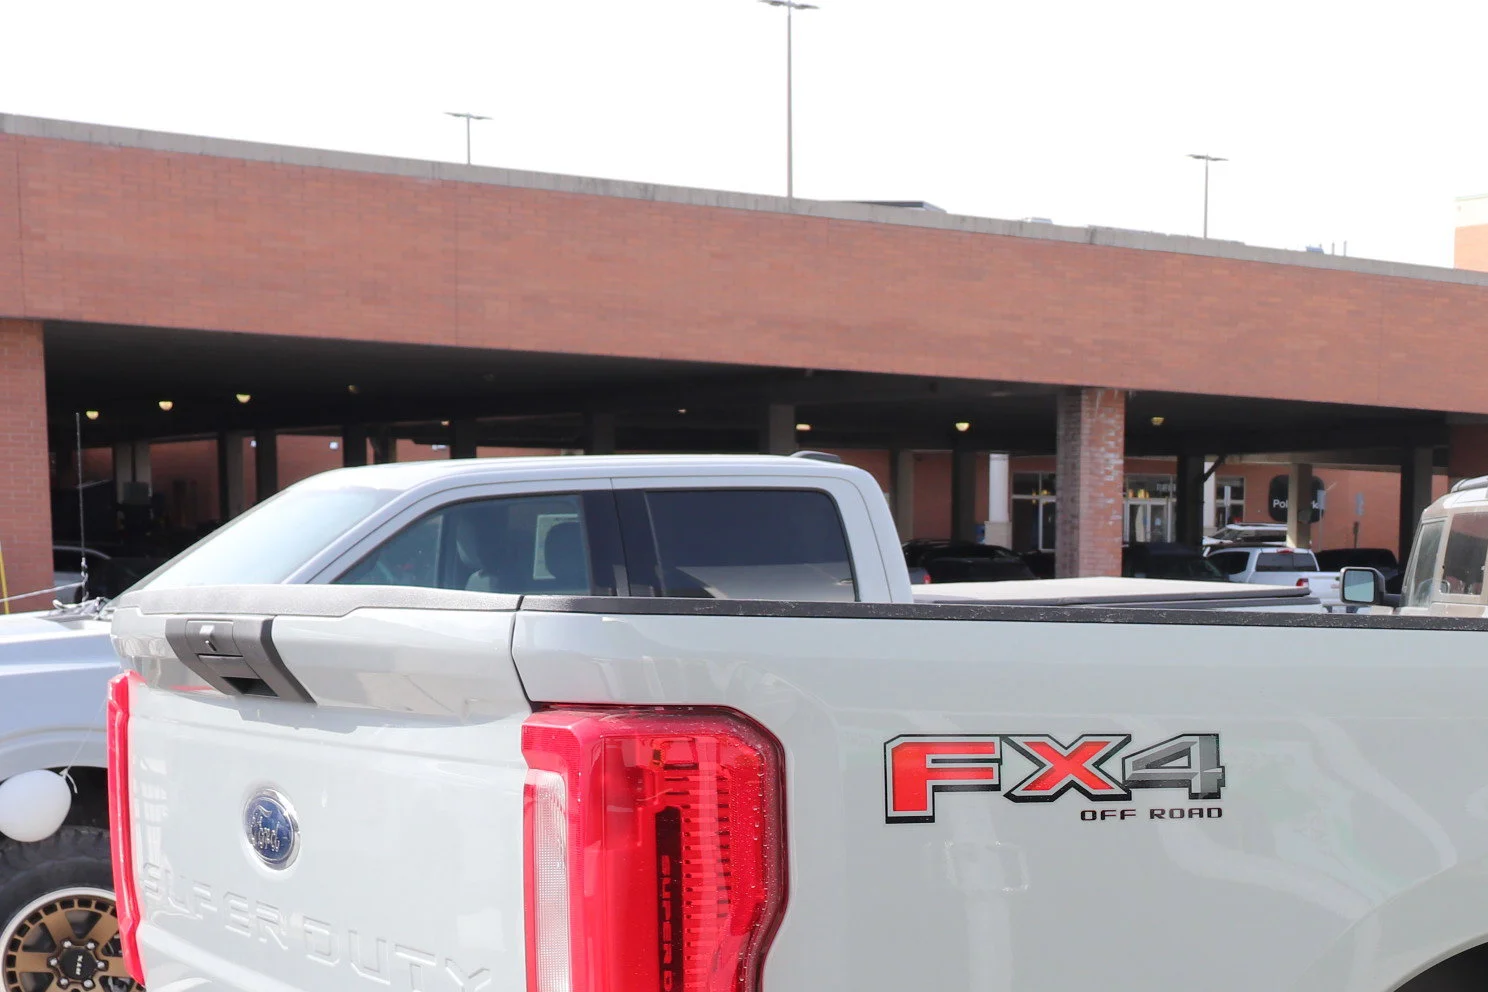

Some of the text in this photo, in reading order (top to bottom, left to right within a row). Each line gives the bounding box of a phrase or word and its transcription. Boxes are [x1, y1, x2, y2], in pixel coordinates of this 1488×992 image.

[884, 733, 1226, 824] FX4
[1080, 806, 1224, 822] OFF ROAD
[251, 804, 281, 853] Ford
[142, 861, 290, 950] SUPER
[661, 855, 673, 965] SUPER
